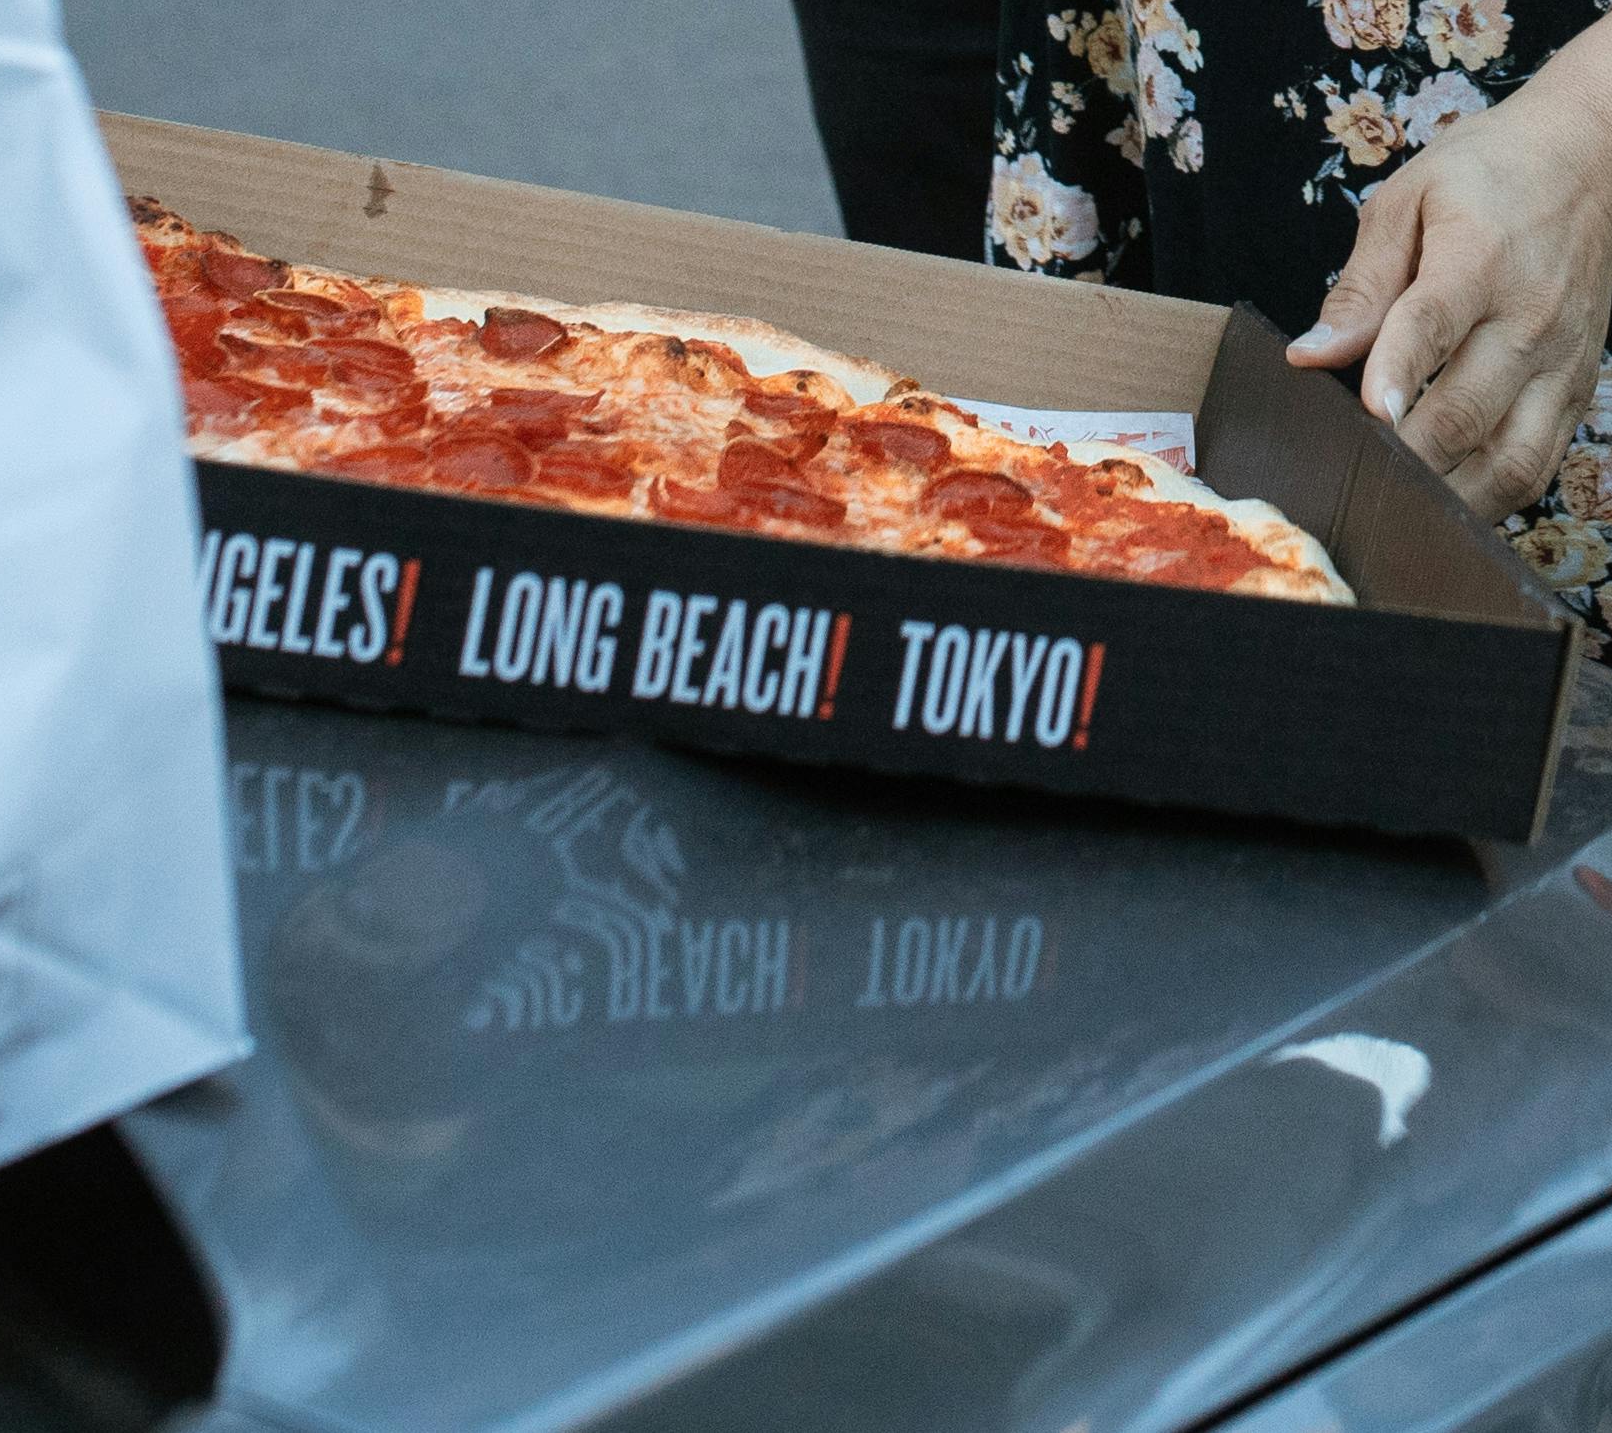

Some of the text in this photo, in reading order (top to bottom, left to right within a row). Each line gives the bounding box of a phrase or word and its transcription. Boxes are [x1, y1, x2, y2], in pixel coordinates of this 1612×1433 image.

[458, 566, 625, 694] LONG
[631, 589, 853, 721] BEACH!
[892, 619, 1107, 751] TOKYO!
